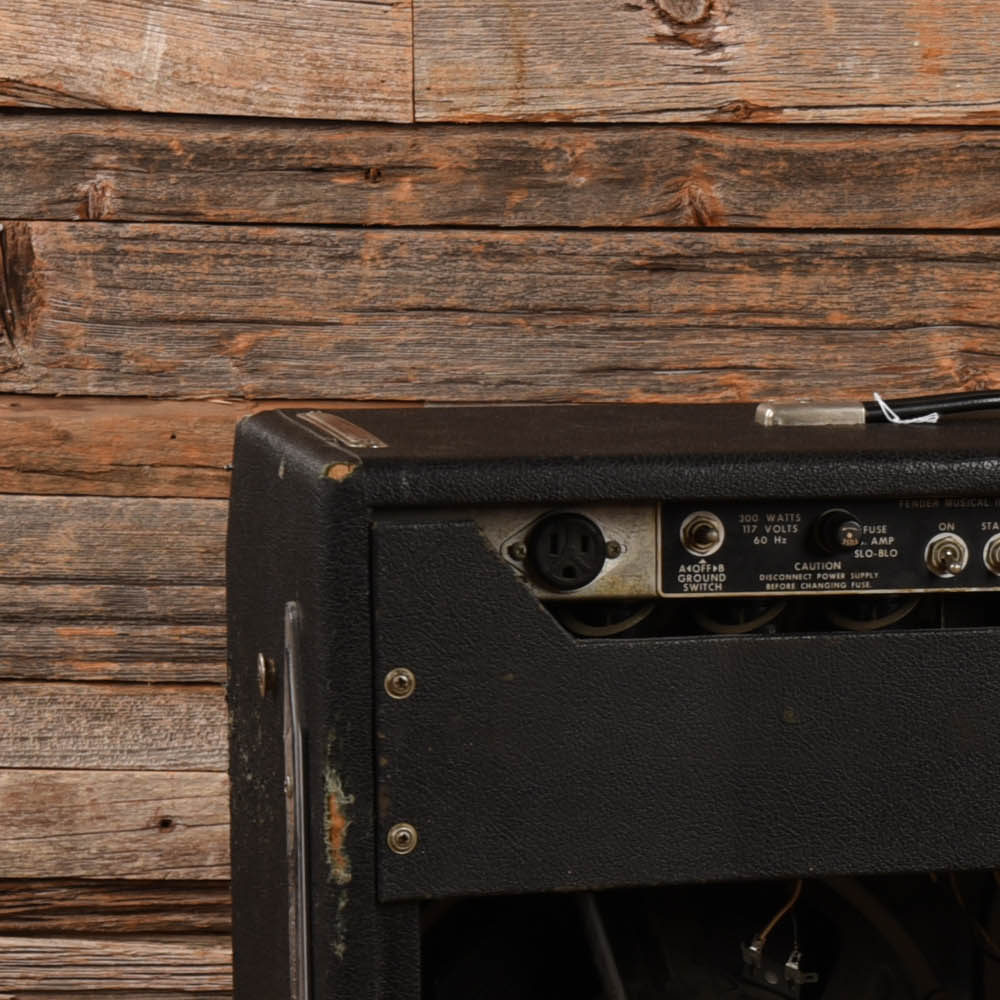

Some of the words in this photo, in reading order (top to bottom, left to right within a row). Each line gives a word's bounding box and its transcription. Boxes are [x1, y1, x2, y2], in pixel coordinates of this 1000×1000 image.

[944, 497, 992, 508] MUSICAL
[766, 513, 801, 522] WATTS
[743, 525, 758, 534] 117
[765, 524, 799, 534] VOLTS
[863, 525, 888, 534] FUSE
[938, 522, 955, 531] ON
[753, 536, 768, 545] 60
[774, 536, 787, 544] Hz
[871, 536, 895, 545] AMP
[854, 549, 898, 558] SLO-BLO
[794, 561, 842, 570] CAUTION
[677, 574, 727, 583] GROUND
[850, 572, 879, 580] SUPPLY
[682, 583, 723, 592] SWITCH
[800, 582, 847, 590] CHANGING
